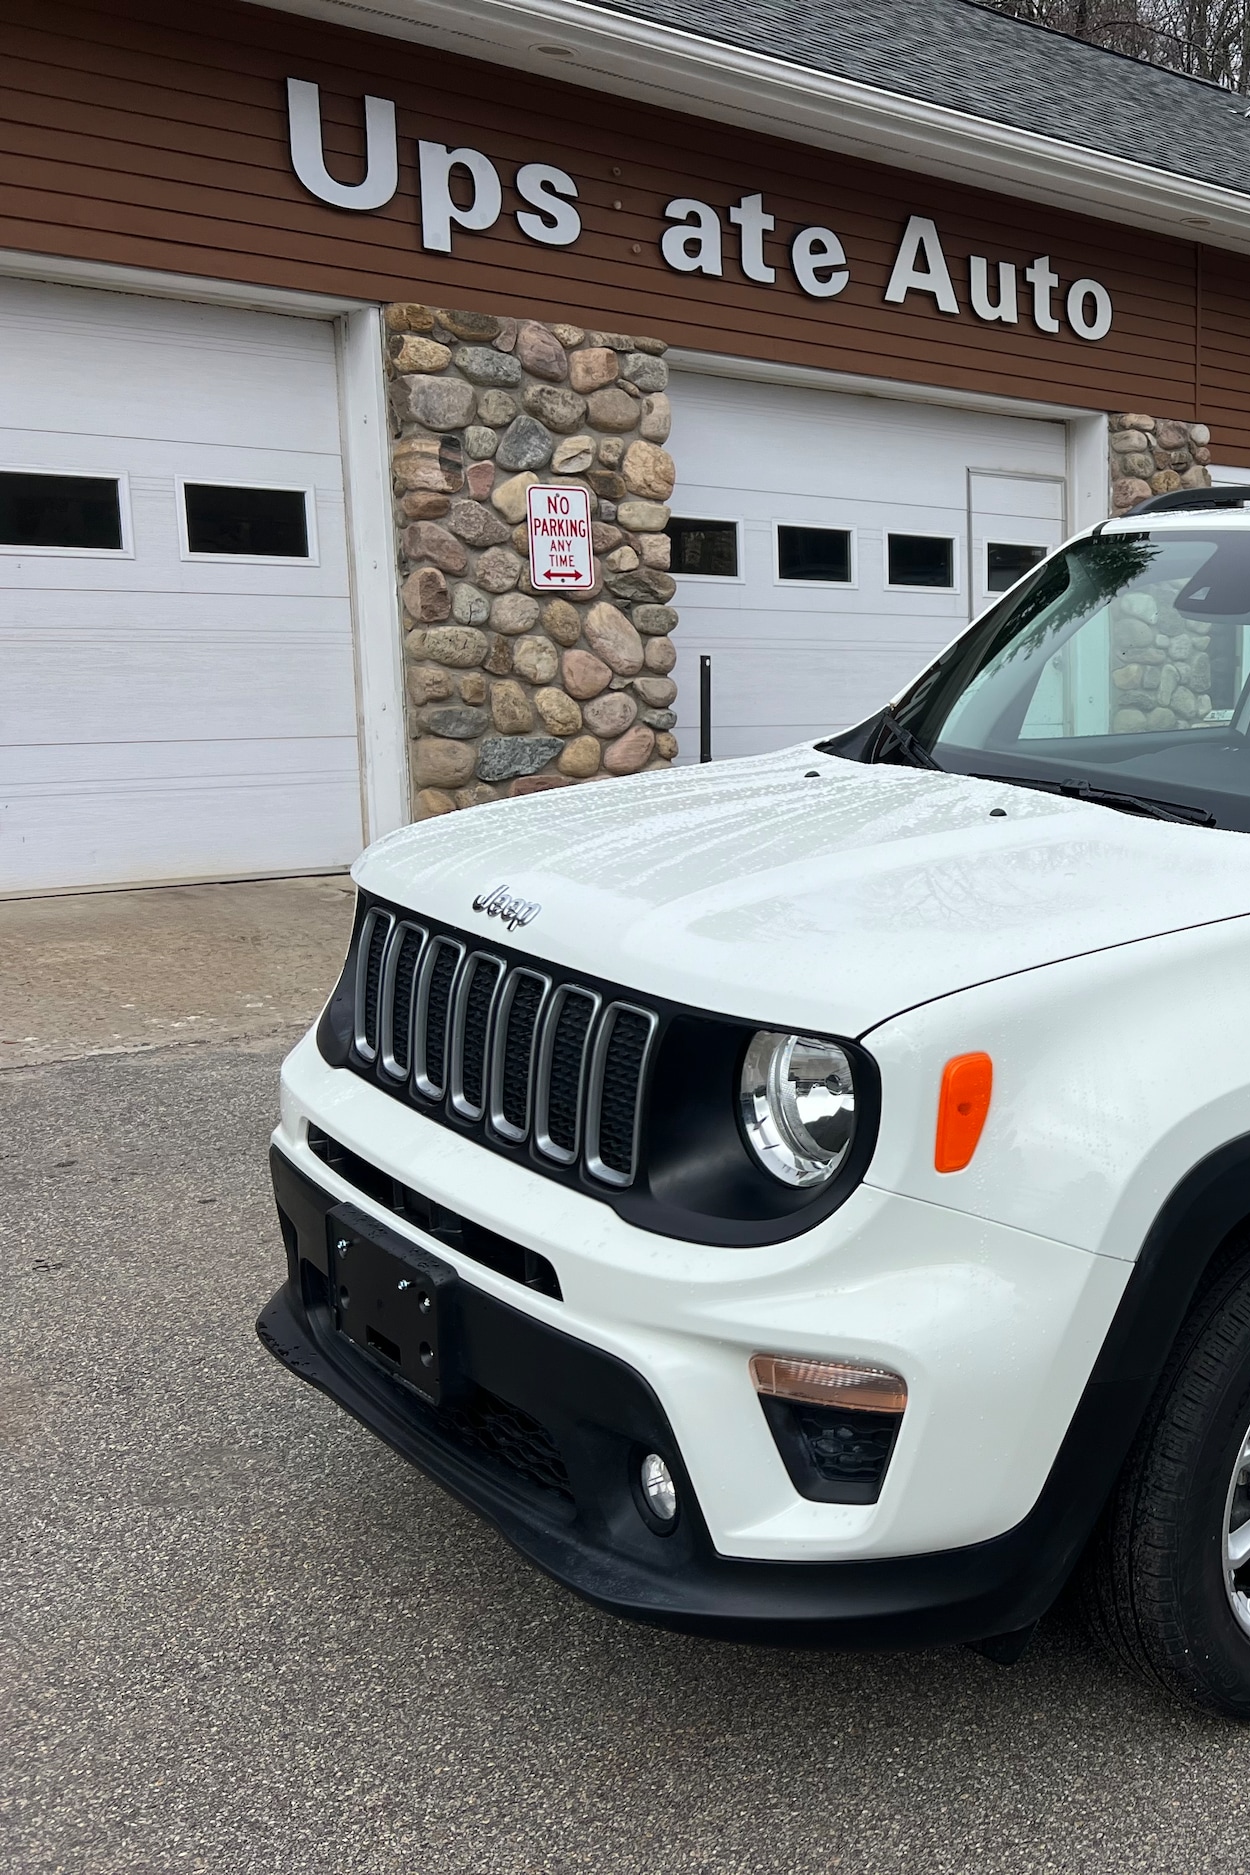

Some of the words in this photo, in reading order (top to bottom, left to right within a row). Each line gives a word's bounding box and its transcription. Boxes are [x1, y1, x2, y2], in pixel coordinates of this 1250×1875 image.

[884, 214, 1114, 342] Auto
[547, 496, 570, 514] NO
[534, 518, 586, 538] PARKING
[550, 539, 572, 552] ANY
[549, 554, 575, 568] TIME
[472, 884, 542, 932] Jeep
